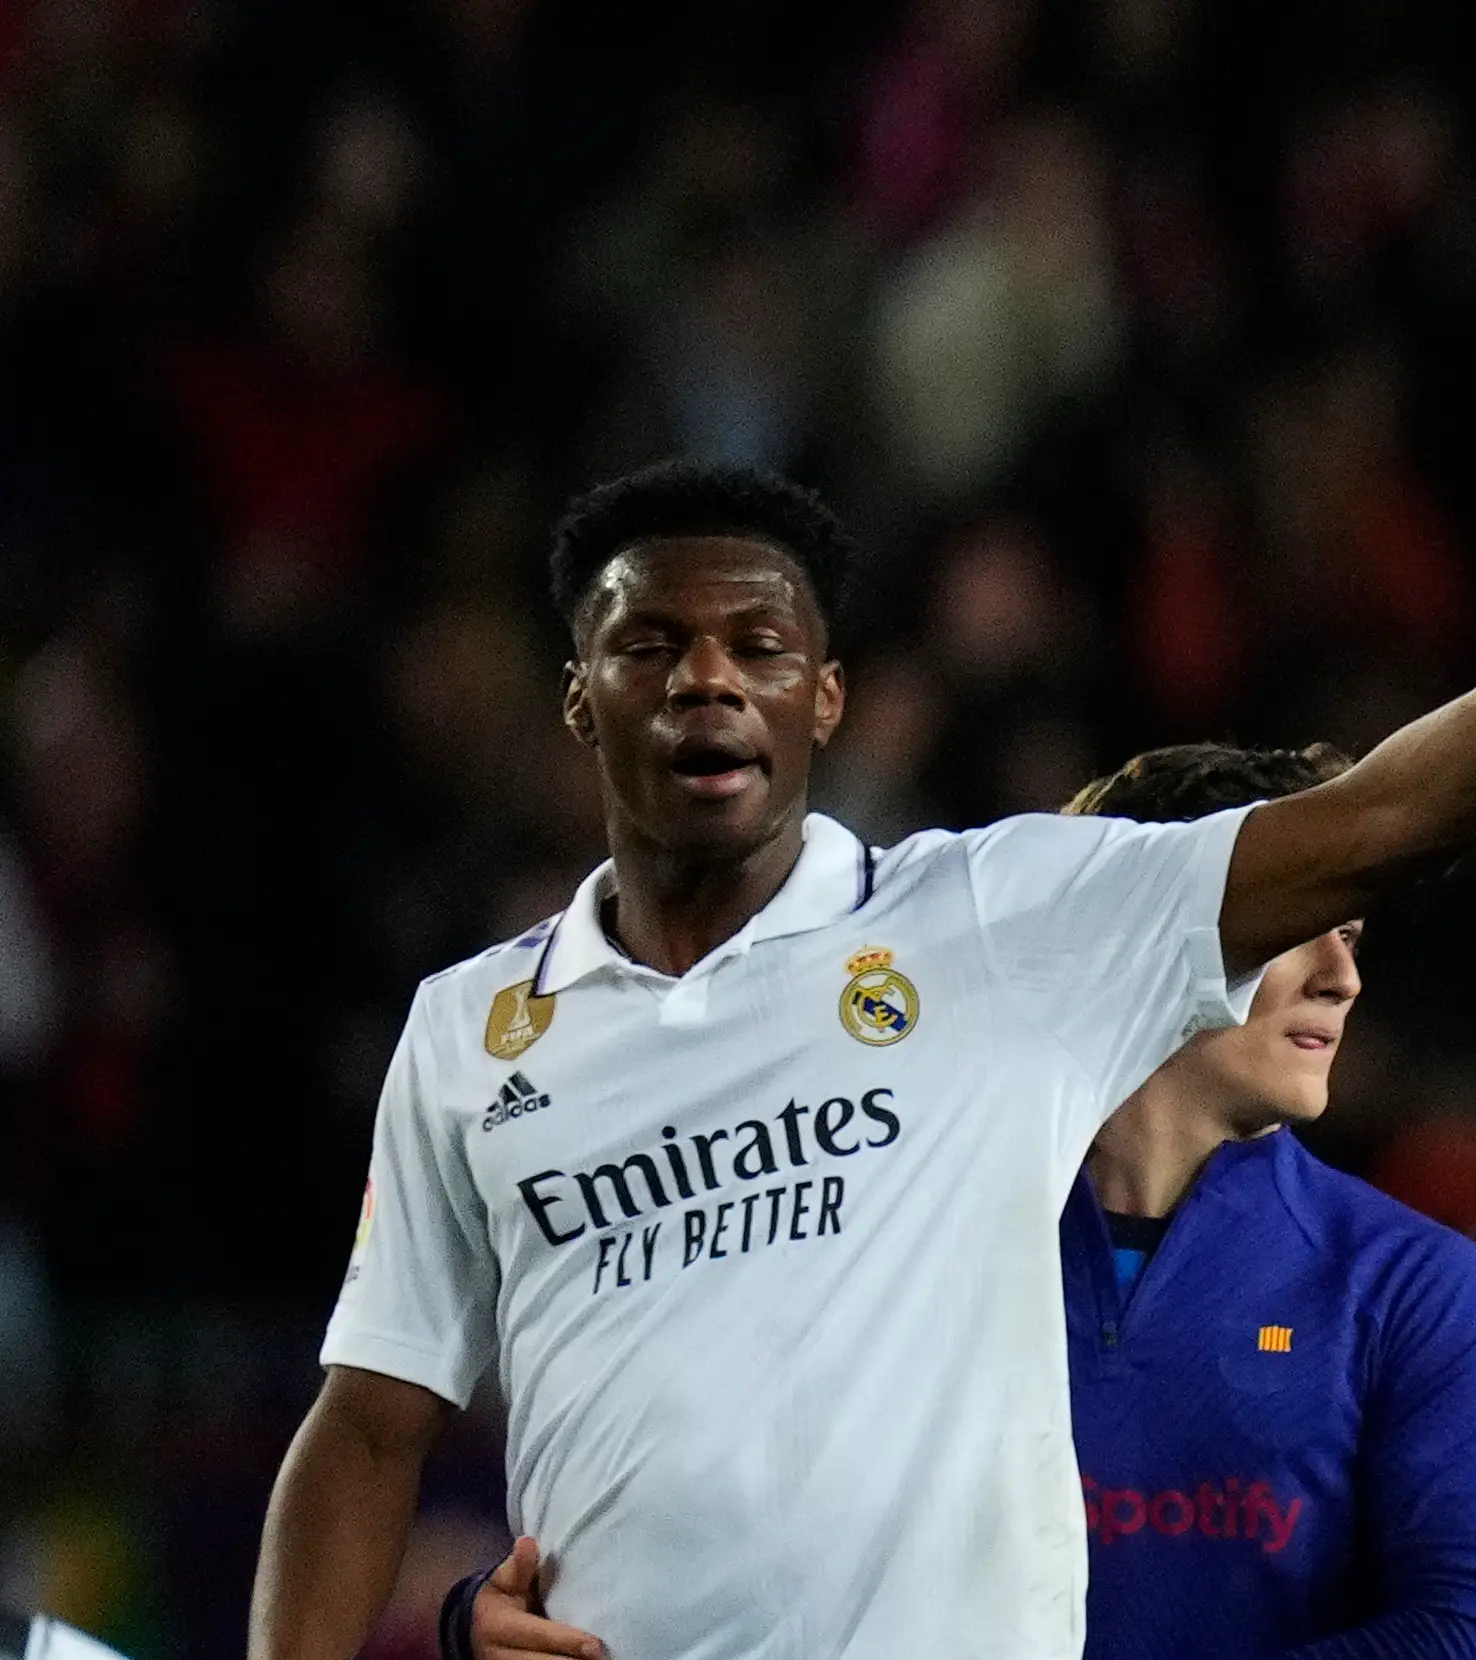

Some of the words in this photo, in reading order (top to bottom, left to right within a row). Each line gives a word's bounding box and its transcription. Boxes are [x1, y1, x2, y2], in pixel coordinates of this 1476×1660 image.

[482, 1093, 552, 1133] adidas
[516, 1087, 901, 1247] Emirates
[592, 1221, 664, 1296] FLY
[681, 1175, 845, 1270] BETTER
